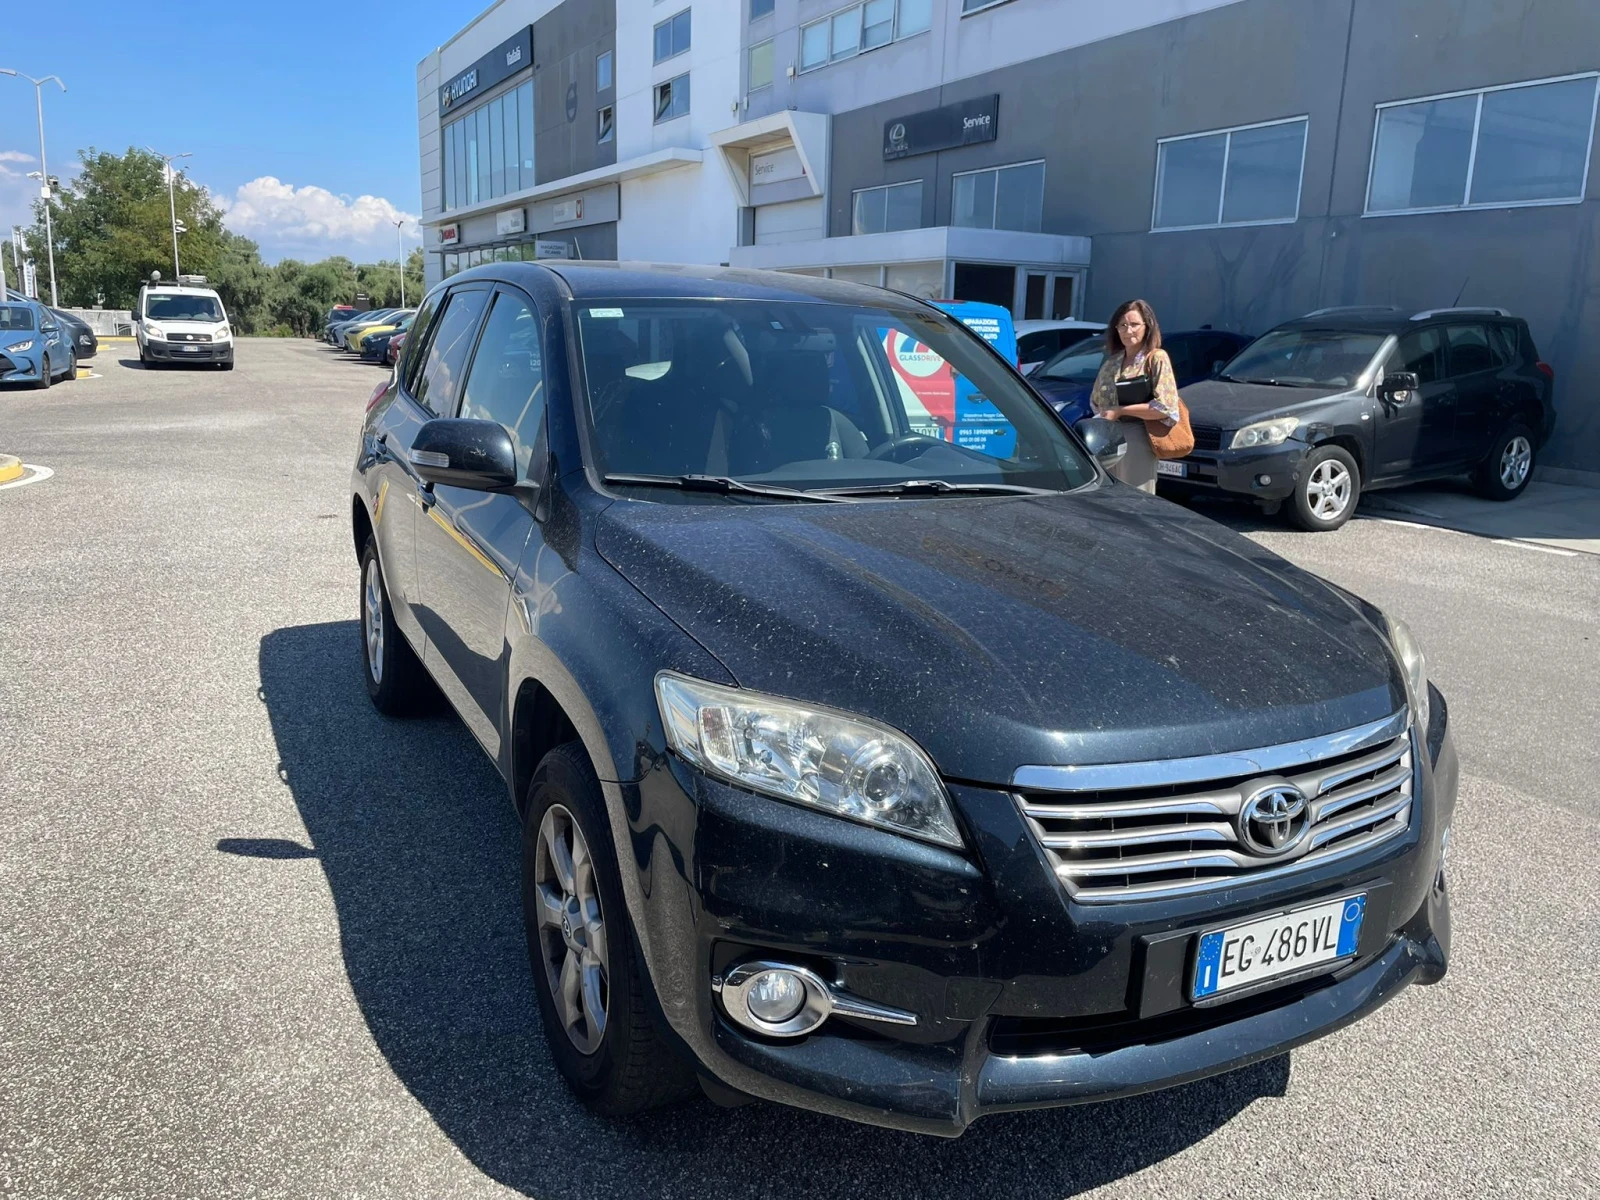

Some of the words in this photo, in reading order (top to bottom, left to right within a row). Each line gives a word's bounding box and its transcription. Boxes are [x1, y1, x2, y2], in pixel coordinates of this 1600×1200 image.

[451, 69, 477, 101] HYUNDAI
[962, 114, 991, 130] Service
[754, 162, 775, 176] Service
[899, 352, 942, 362] GLASSDRIVE
[1221, 935, 1255, 978] EG
